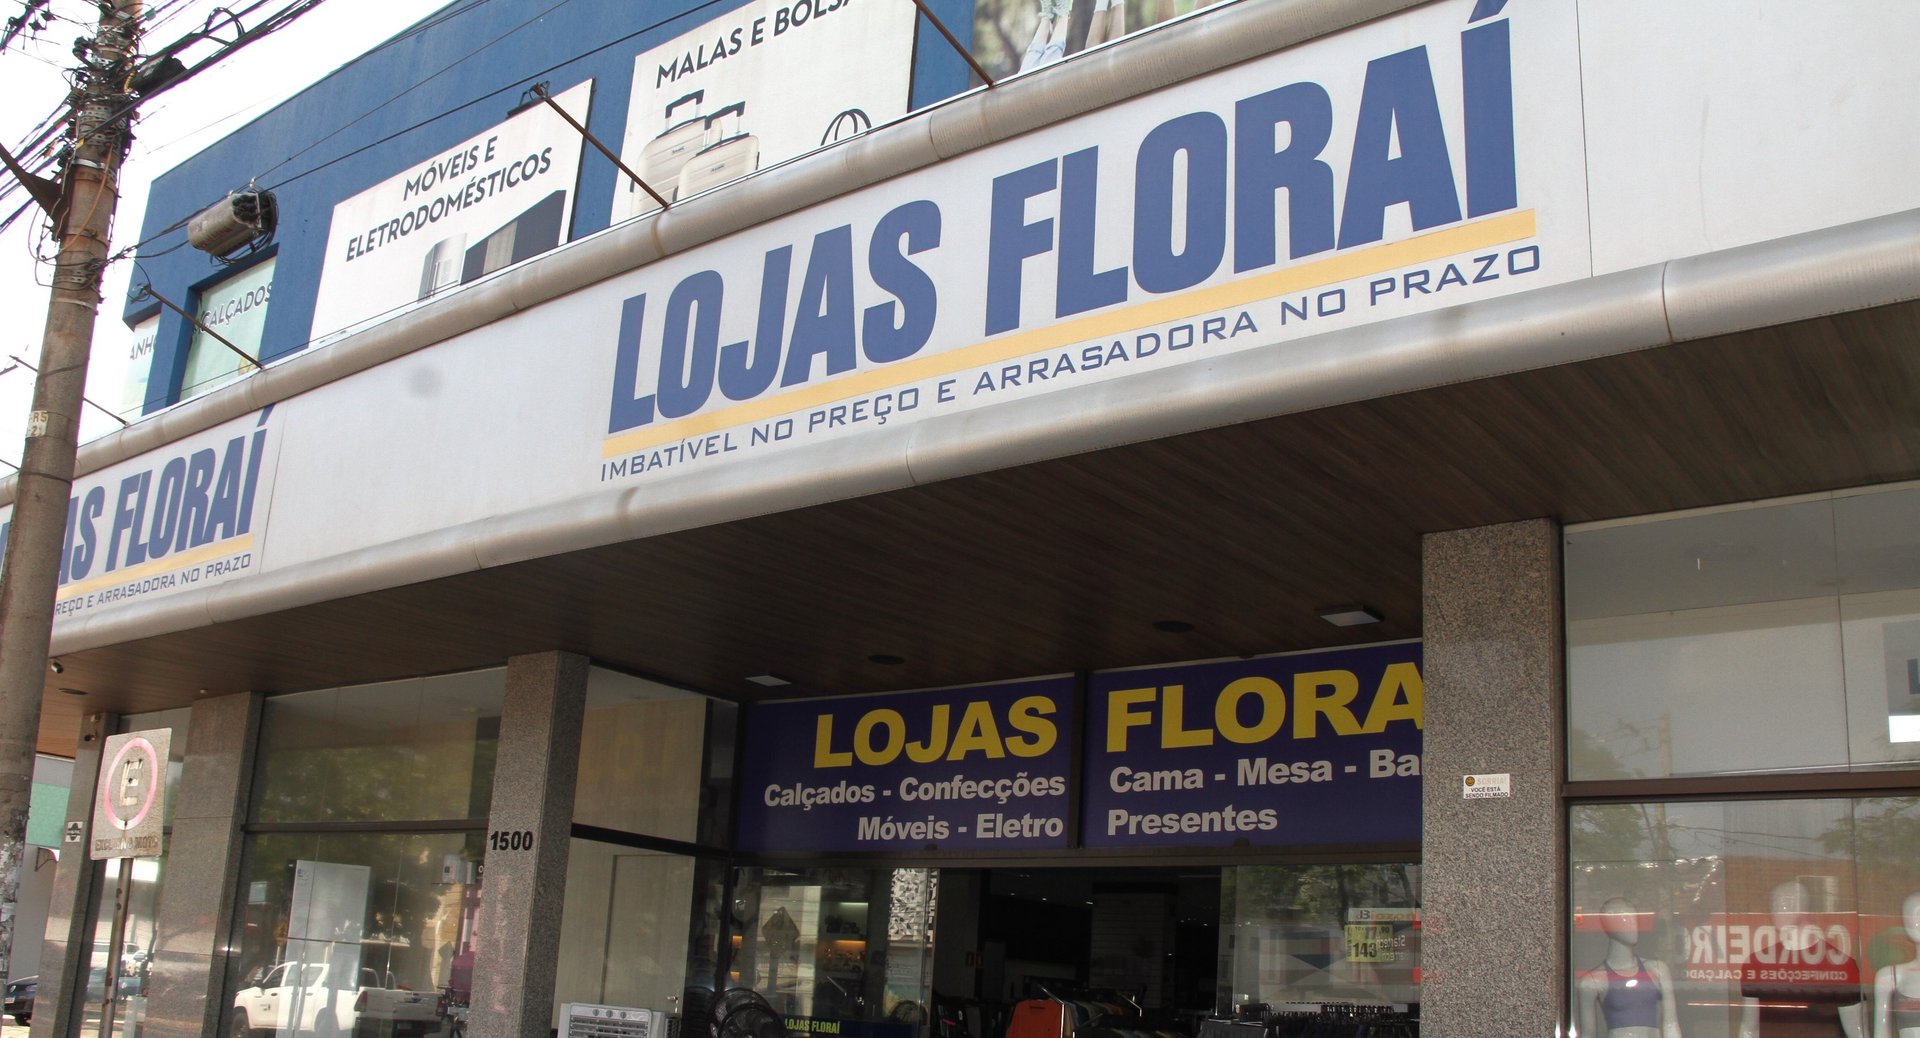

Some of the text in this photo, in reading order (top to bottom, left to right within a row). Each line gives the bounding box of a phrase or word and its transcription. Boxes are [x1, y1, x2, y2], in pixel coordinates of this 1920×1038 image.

[656, 0, 850, 89] MALAS E BOL
[403, 135, 498, 201] MÓVEIS E
[346, 147, 552, 262] ELETRODOMÉSTICOS
[608, 0, 1518, 434] LOJAS FLORAÍ
[130, 335, 156, 360] ANH
[601, 245, 1541, 482] IMBATÍVEL NO PREÇO E ARRASADORA NO PRAZO
[105, 402, 277, 573] FLORAÍ
[55, 553, 251, 616] REÇO E ARRASADORA NO PRAZO
[814, 662, 1423, 768] LOJAS FLORA
[764, 780, 875, 811] Calçados
[900, 772, 1066, 804] Confecções
[1110, 766, 1204, 793] Cama
[1237, 757, 1333, 786] Mesa
[1369, 749, 1423, 778] Ba
[490, 831, 533, 851] 1500
[857, 815, 949, 840] Móveis
[976, 812, 1064, 839] Eletro
[1107, 804, 1278, 836] Presentes
[785, 1018, 810, 1031] LOJAS
